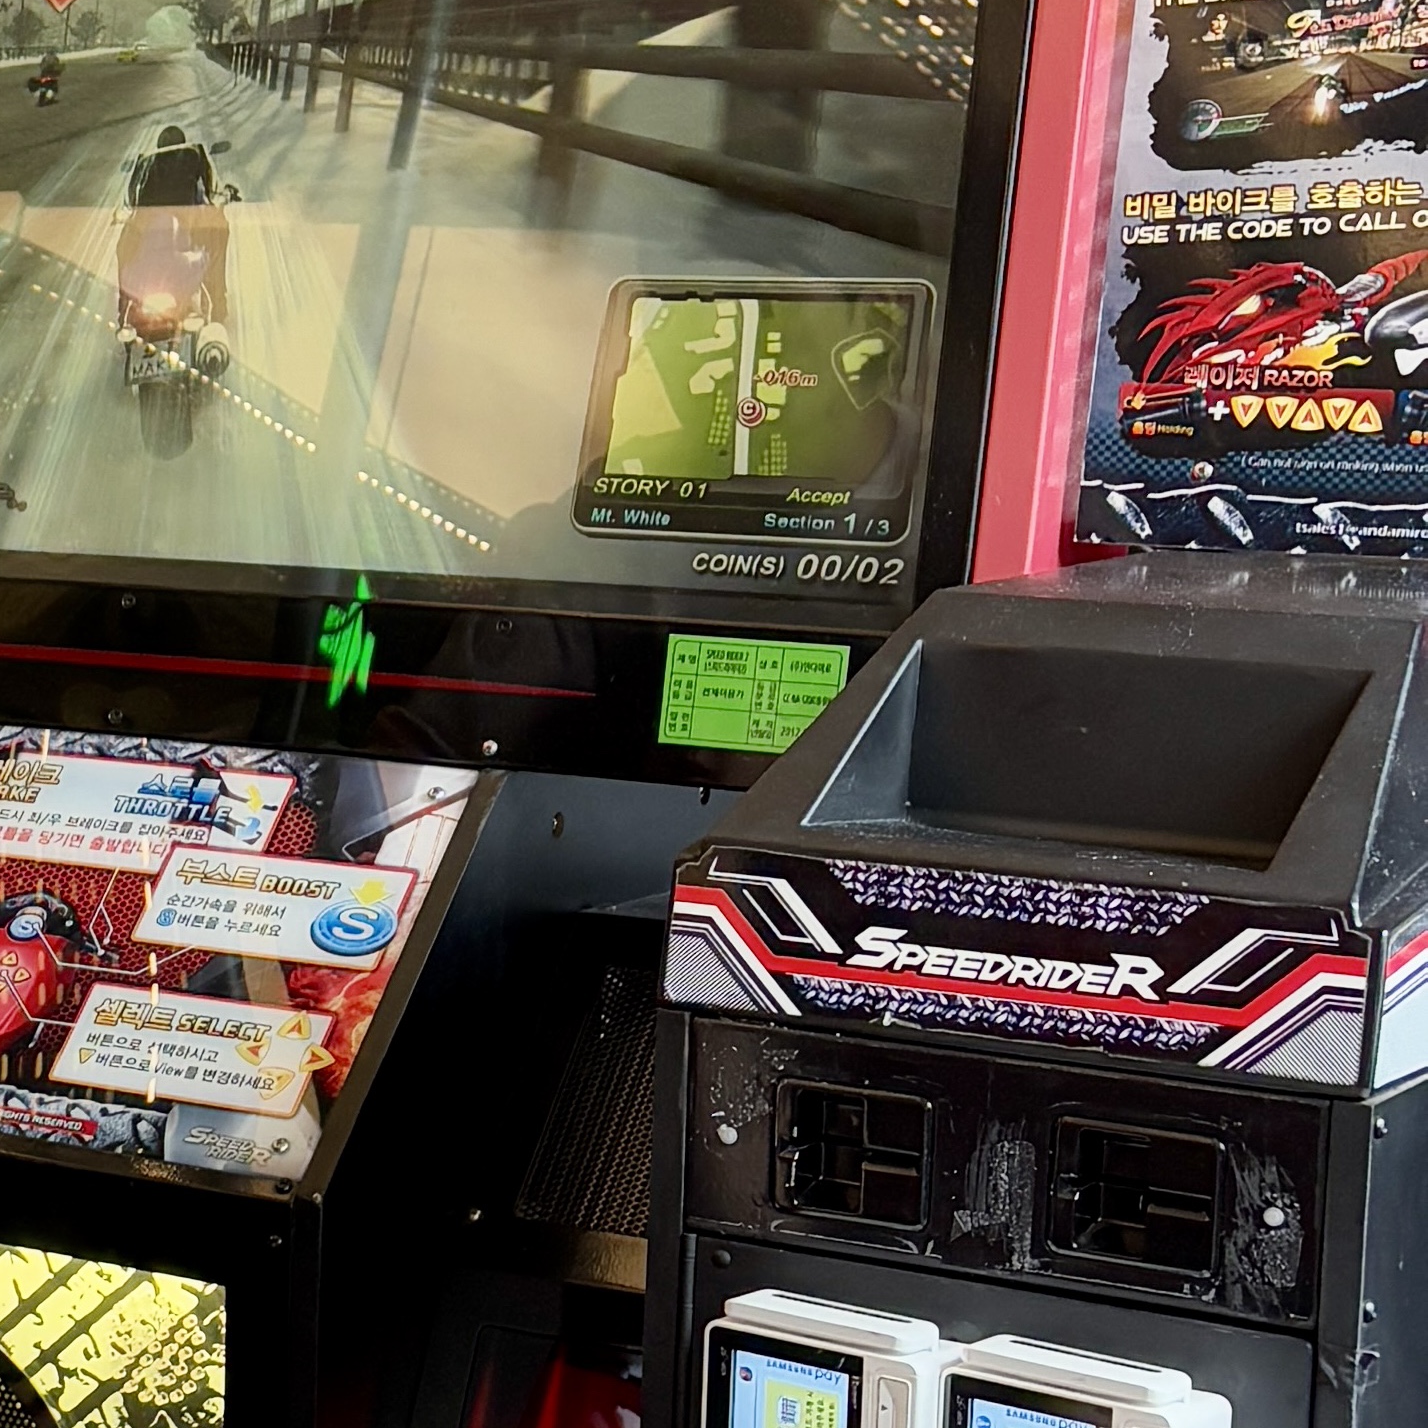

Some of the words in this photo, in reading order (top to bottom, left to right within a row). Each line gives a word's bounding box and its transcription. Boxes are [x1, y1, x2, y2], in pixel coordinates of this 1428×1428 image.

[1125, 191, 1177, 219] 비밀
[1188, 185, 1298, 216] 바이크를
[1307, 179, 1423, 210] 호출하는
[1122, 225, 1170, 245] USE
[1176, 223, 1222, 242] THE
[1227, 218, 1293, 240] CODE
[1298, 217, 1331, 235] TO
[1339, 211, 1405, 232] CALL
[1264, 370, 1334, 388] RAZOR
[595, 478, 668, 496] STORY
[680, 481, 708, 498] 01
[787, 488, 852, 505] Accept
[624, 510, 670, 526] White
[764, 514, 834, 530] Section
[693, 553, 784, 578] COIN(S)
[797, 555, 904, 585] 00/02
[114, 795, 232, 823] THROTTLE
[177, 858, 260, 889] 부스트
[260, 875, 340, 899] BOOST
[243, 902, 286, 919] 위해서
[178, 914, 220, 929] 버튼을
[225, 919, 281, 937] 누르세요
[845, 925, 1166, 1002] SPEEDRIDER
[94, 998, 176, 1032] 셀렉트
[176, 1014, 272, 1042] SELECT
[87, 1032, 141, 1051] 버튼으로
[96, 1053, 151, 1072] 버튼으로
[202, 1066, 275, 1091] 변경하세요
[184, 1126, 256, 1151] SPEED
[207, 1146, 272, 1166] RIDER
[815, 1369, 842, 1385] pay
[1006, 1408, 1057, 1427] SAMSUNG
